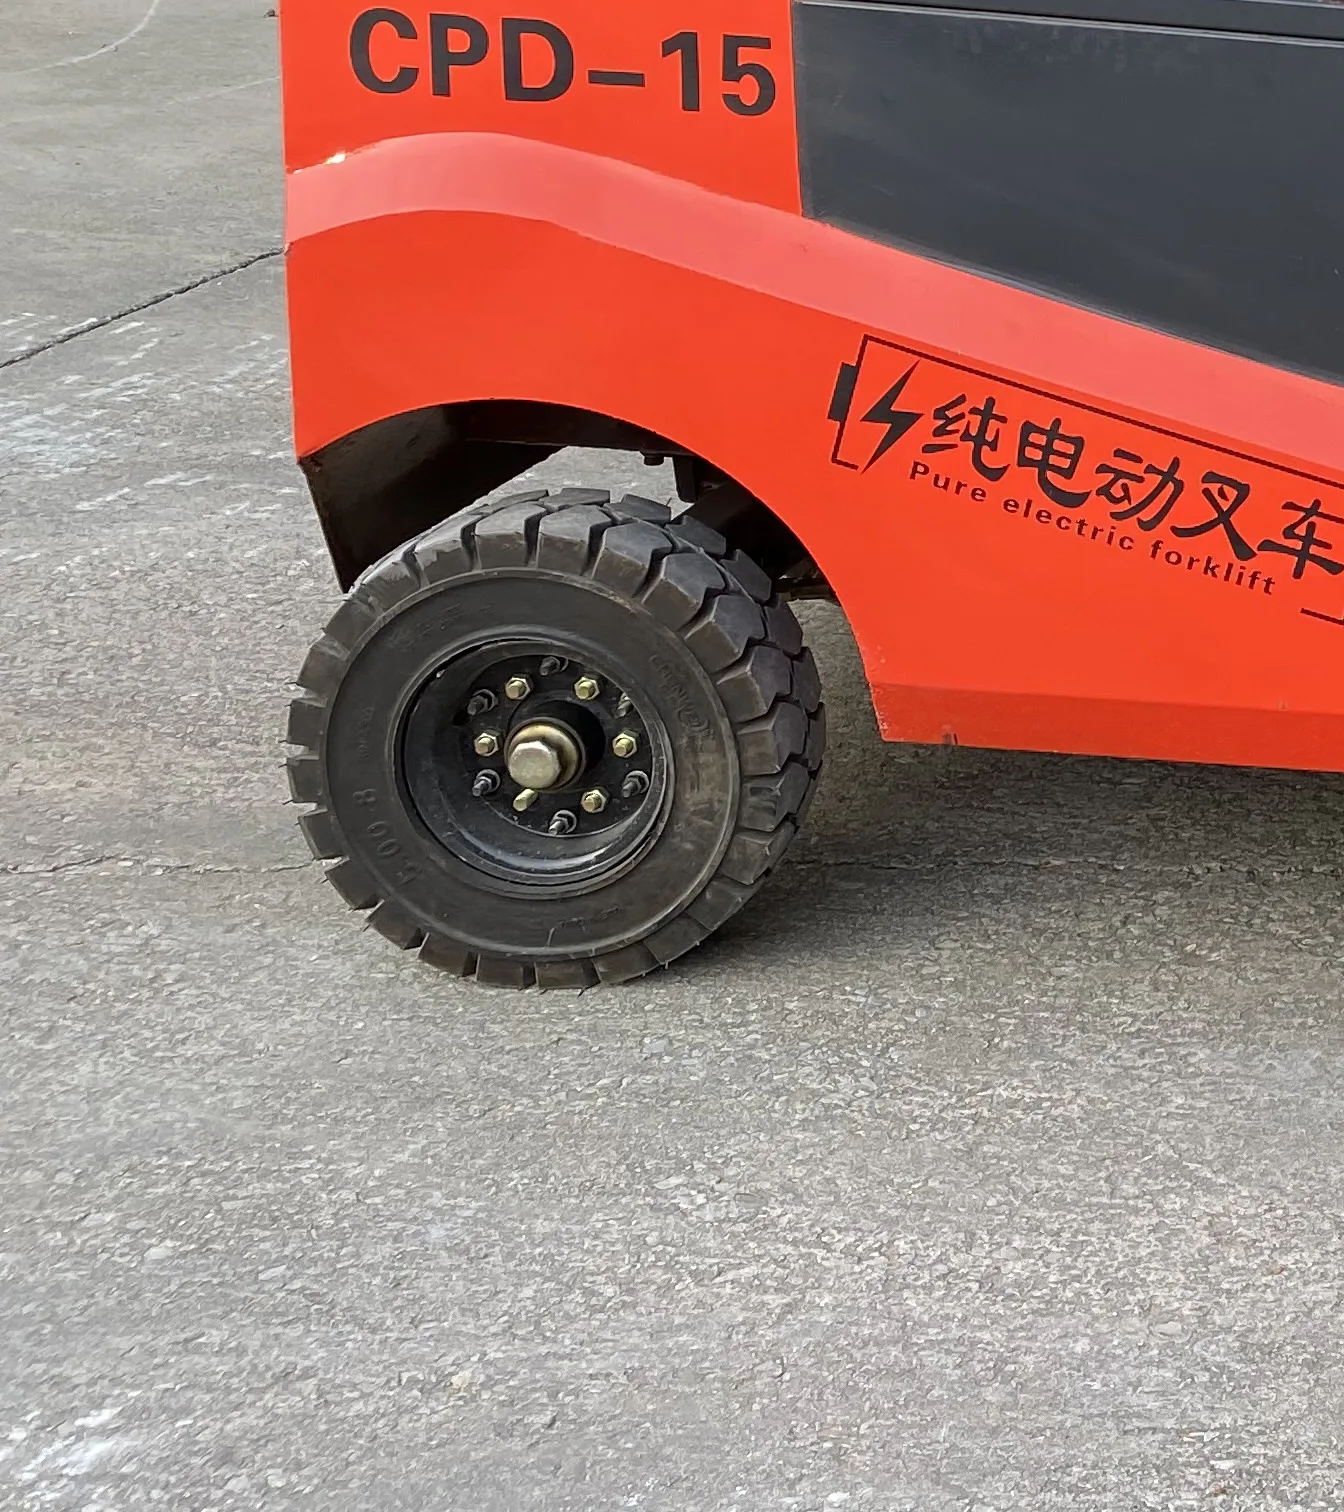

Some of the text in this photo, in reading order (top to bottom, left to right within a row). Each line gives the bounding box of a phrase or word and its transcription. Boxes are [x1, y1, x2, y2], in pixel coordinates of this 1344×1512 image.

[349, 7, 777, 117] CPD-15
[909, 460, 1277, 595] Pure electric forklift
